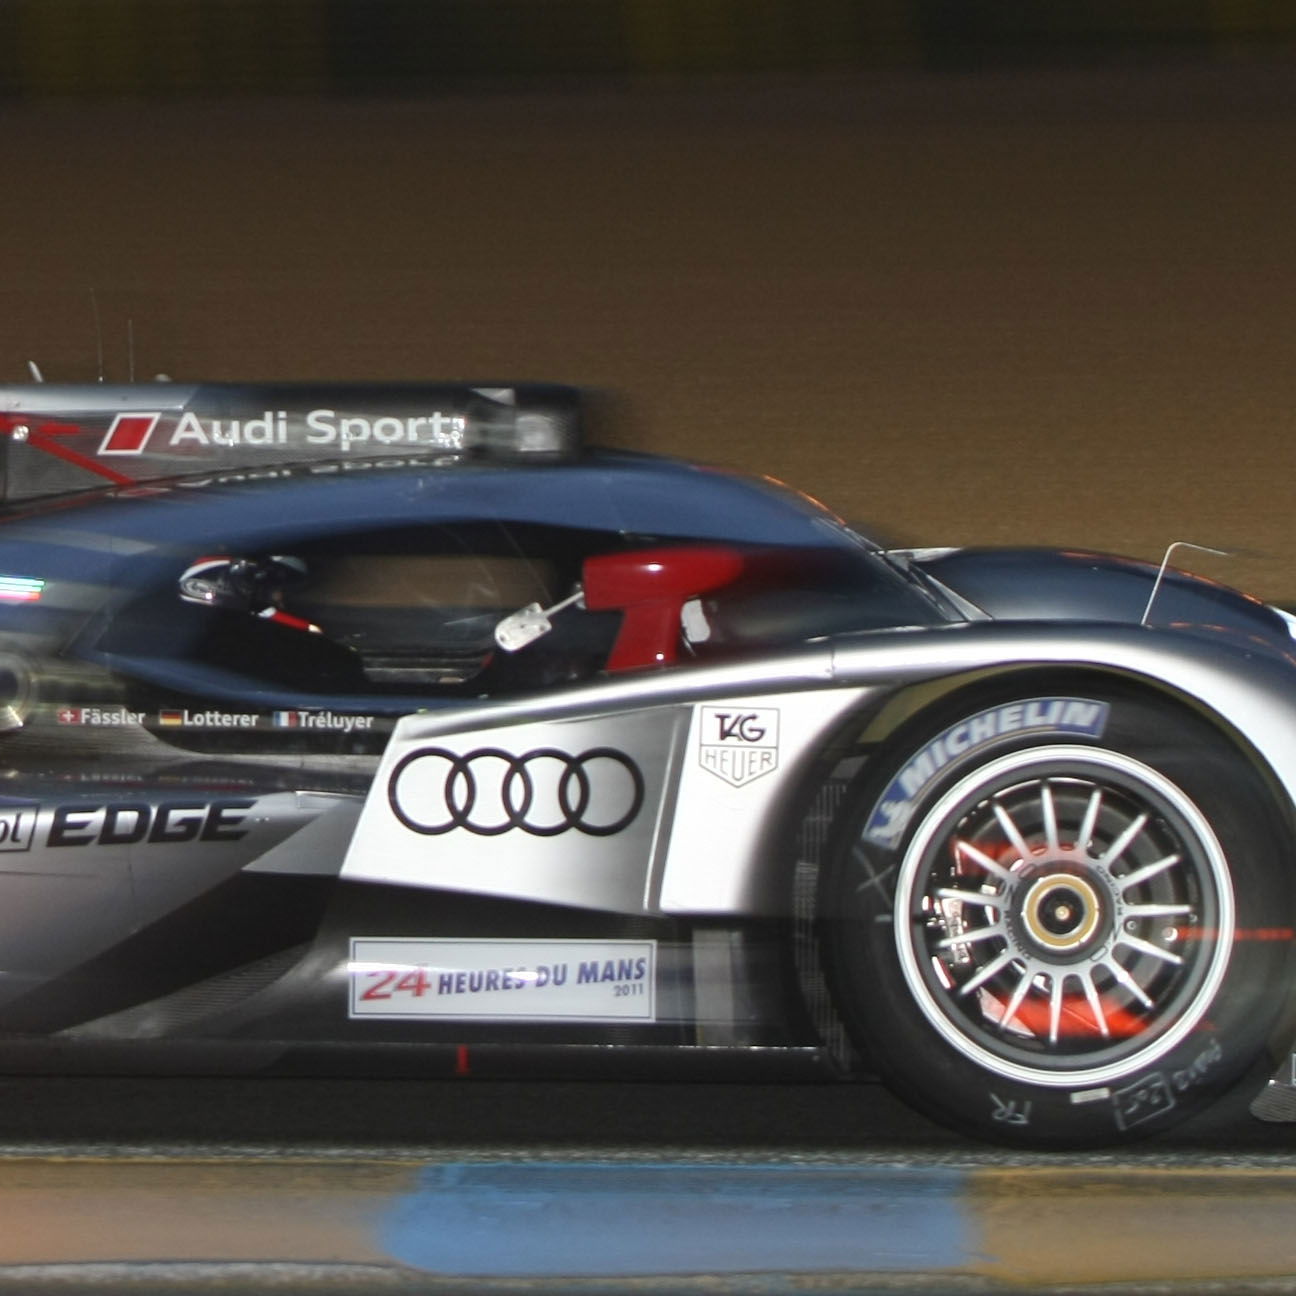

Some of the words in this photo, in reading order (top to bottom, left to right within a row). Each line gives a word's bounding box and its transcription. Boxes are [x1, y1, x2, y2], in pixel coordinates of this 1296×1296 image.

[170, 410, 288, 446] Audi
[306, 409, 456, 451] Sport
[80, 707, 146, 726] Fässler
[183, 709, 259, 727] Lotterer
[298, 710, 374, 733] Tréluyer
[713, 713, 768, 743] TAG
[705, 749, 773, 782] HEUER
[898, 700, 1101, 798] MICHELIN
[45, 800, 257, 849] EDGE
[359, 964, 432, 1001] 24
[437, 967, 526, 996] HEURES
[535, 964, 568, 988] DU
[576, 957, 647, 985] MANS
[613, 982, 644, 997] 2011
